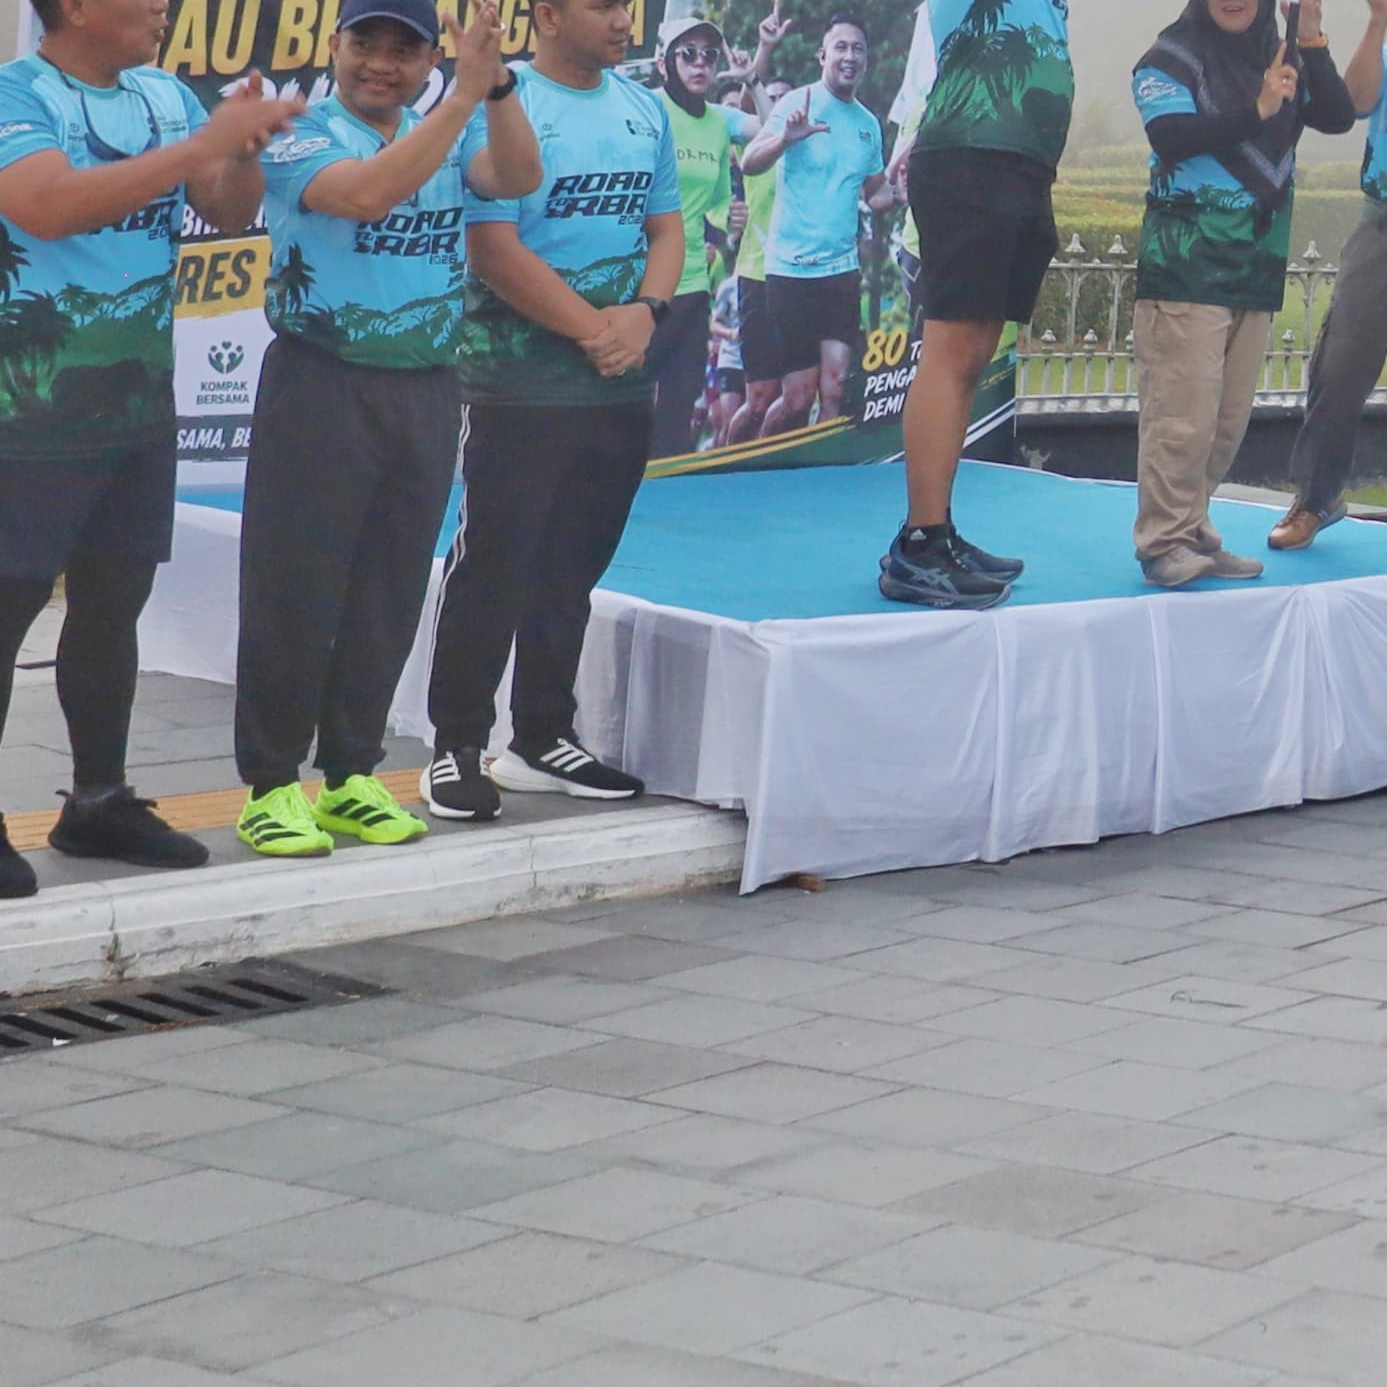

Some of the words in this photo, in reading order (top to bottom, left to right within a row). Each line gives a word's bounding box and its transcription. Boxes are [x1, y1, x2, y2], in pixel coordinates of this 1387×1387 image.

[549, 171, 653, 198] ROAD
[862, 329, 908, 371] 80
[195, 394, 250, 405] BERSAMA
[200, 381, 248, 391] KOMPAK
[863, 393, 905, 422] DEMI
